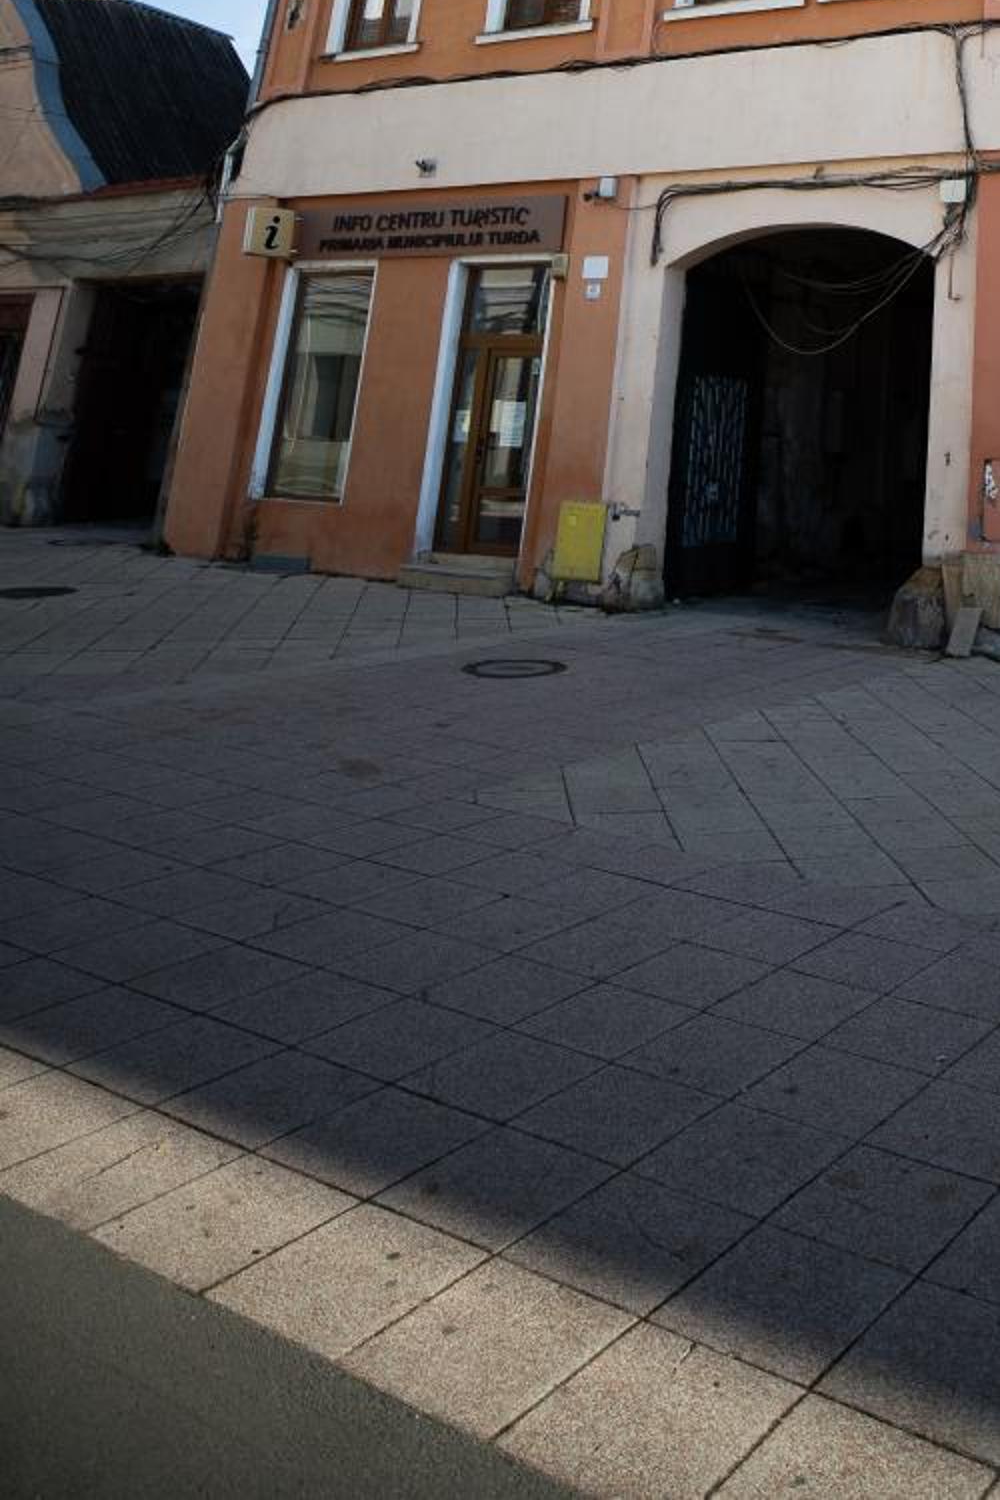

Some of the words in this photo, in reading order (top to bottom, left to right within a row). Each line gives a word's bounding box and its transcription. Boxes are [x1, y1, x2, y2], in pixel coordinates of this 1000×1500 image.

[333, 214, 372, 233] INFO
[376, 209, 445, 232] CENTRU
[450, 206, 531, 229] TURISTIC
[488, 229, 541, 245] TURDA
